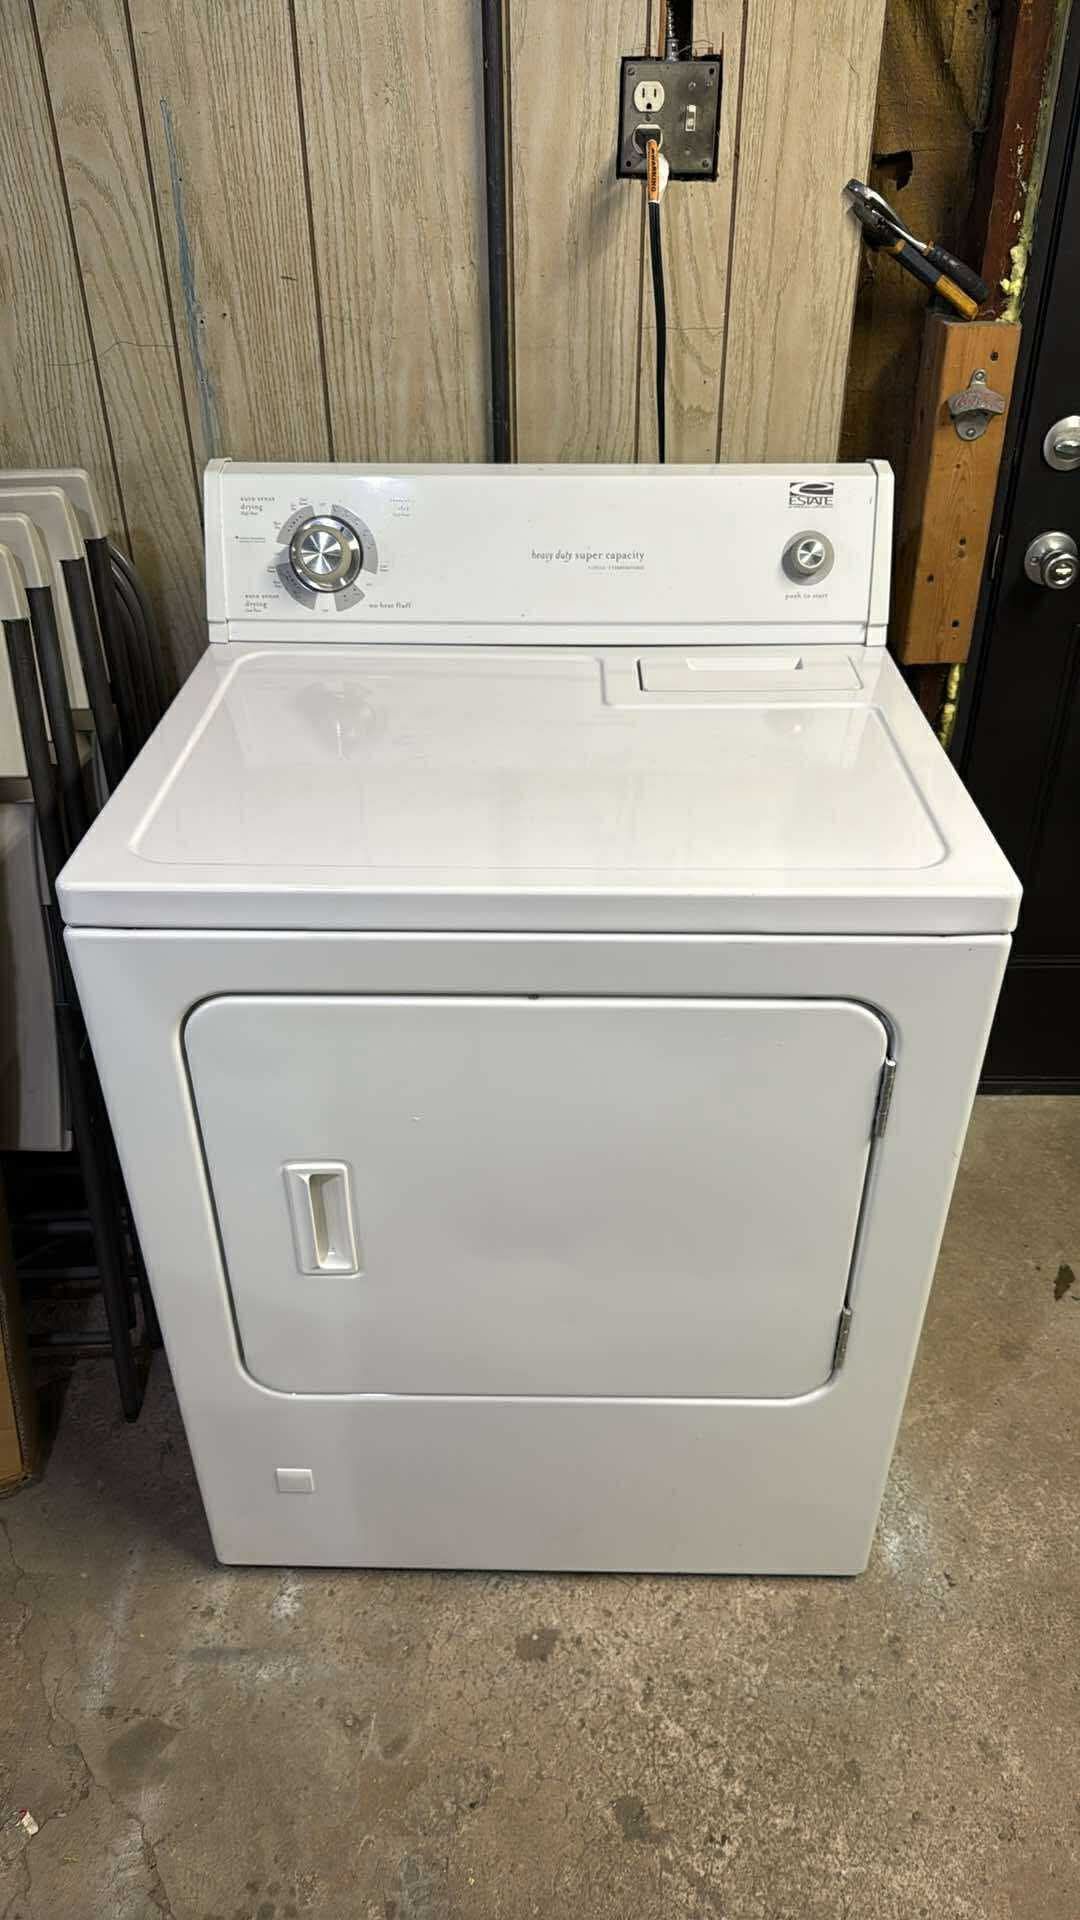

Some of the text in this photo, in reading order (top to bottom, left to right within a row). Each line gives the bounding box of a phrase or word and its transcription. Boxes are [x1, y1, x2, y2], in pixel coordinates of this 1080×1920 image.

[789, 496, 833, 506] ESTATE
[531, 549, 645, 563] heavy duty super capacity
